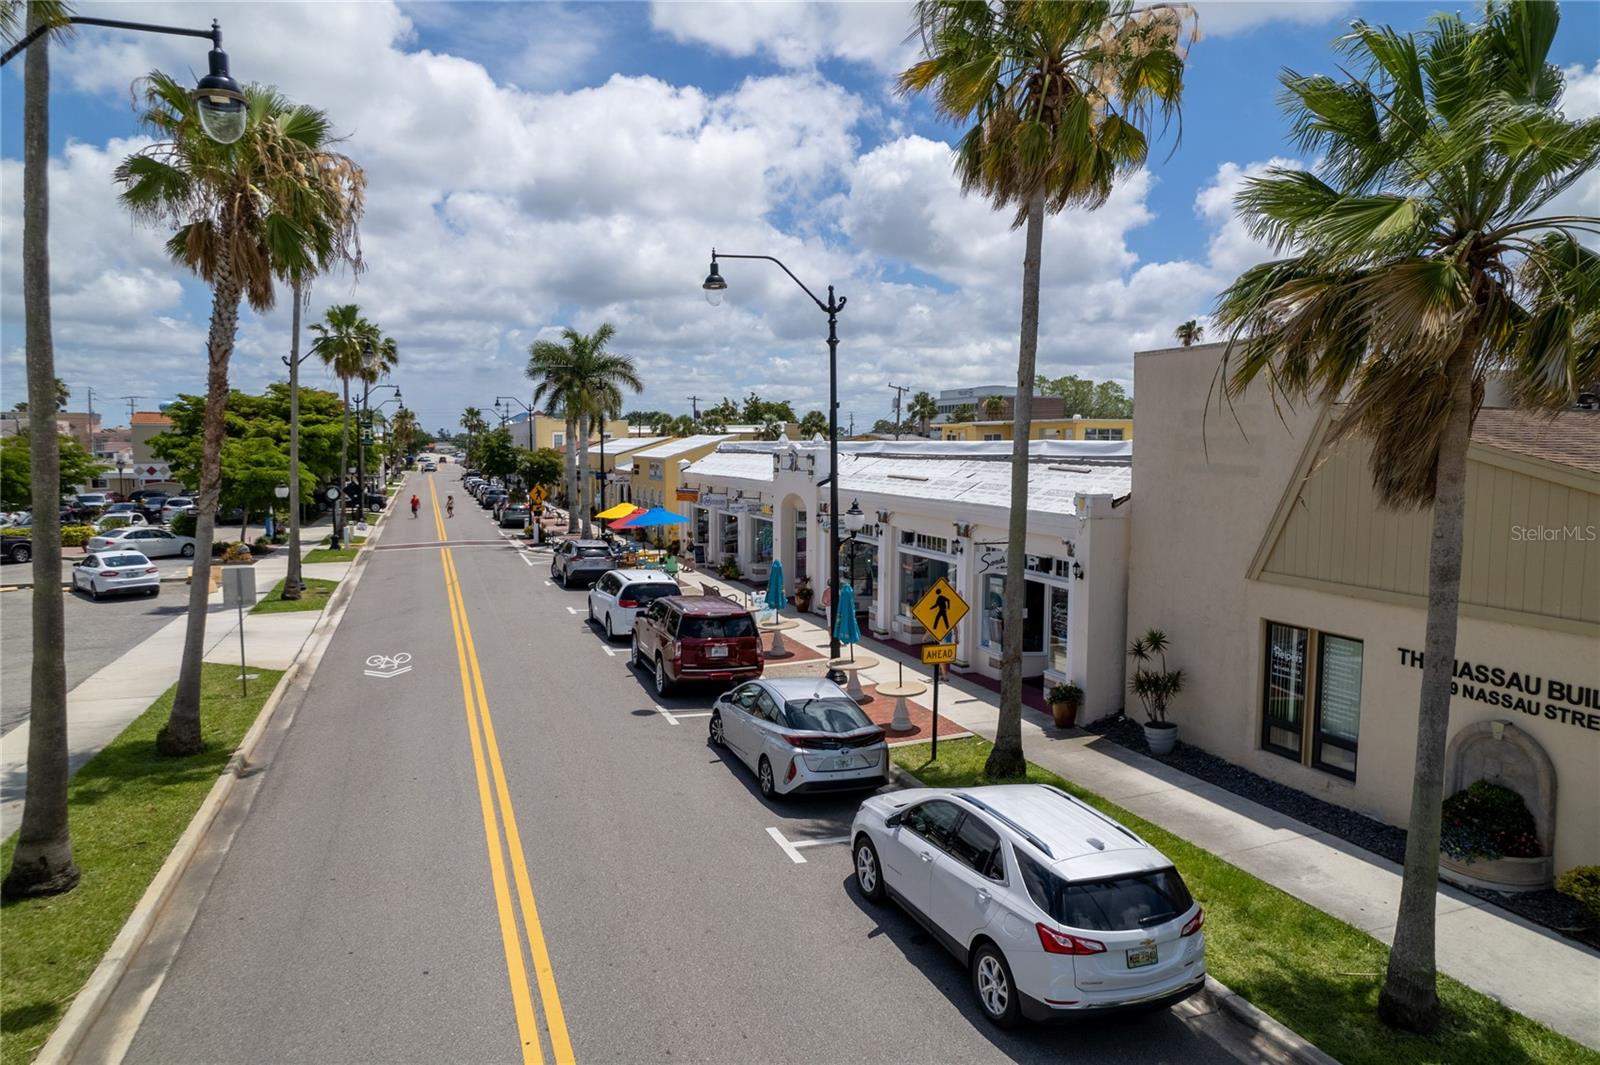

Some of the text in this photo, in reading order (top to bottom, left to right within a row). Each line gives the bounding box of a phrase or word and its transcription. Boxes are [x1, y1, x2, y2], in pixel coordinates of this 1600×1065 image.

[926, 648, 953, 660] AHEAD
[1397, 647, 1424, 669] TH
[1462, 684, 1540, 716] NASSAU
